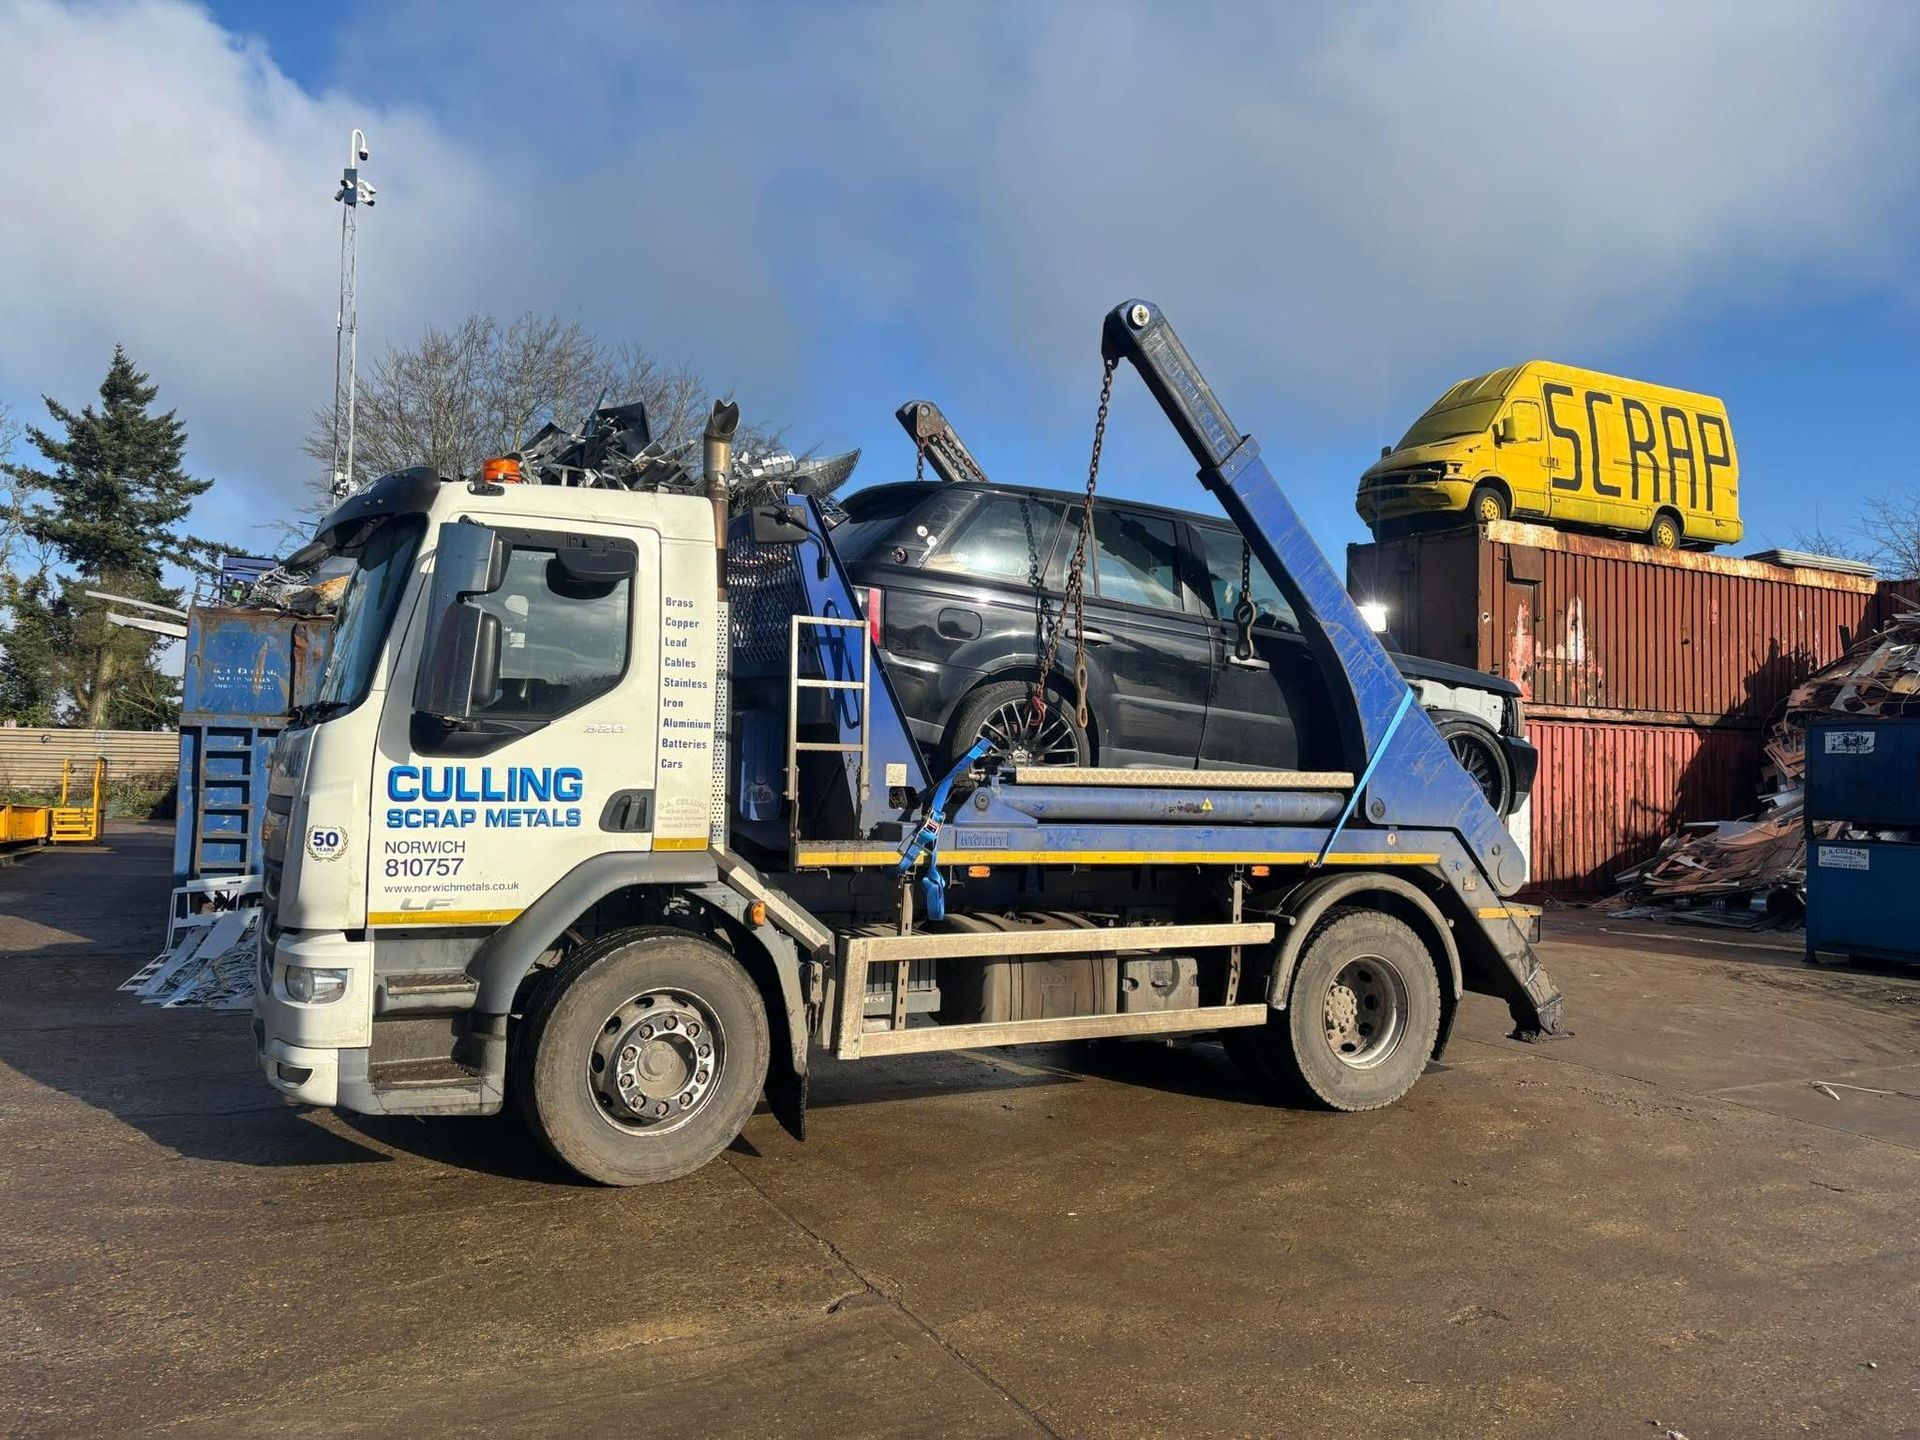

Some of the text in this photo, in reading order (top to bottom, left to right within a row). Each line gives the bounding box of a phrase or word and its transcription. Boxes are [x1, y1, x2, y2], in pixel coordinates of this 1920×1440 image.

[1543, 382, 1731, 512] SCRAP
[665, 596, 694, 608] Brass
[665, 617, 700, 629] Copper
[665, 637, 687, 648] Lead
[664, 657, 696, 669] Cables
[663, 677, 708, 689] Stainless
[663, 698, 684, 709] Iron
[662, 717, 711, 729] Aluminium
[661, 738, 707, 749] Batteries
[660, 758, 683, 769] Cars
[387, 765, 584, 803] CULLING
[386, 808, 582, 829] SCRAP METALS
[312, 831, 339, 847] 50
[384, 840, 466, 854] NORWICH
[384, 857, 464, 877] 810757
[384, 881, 519, 893] www.norwichmetals.co.uk
